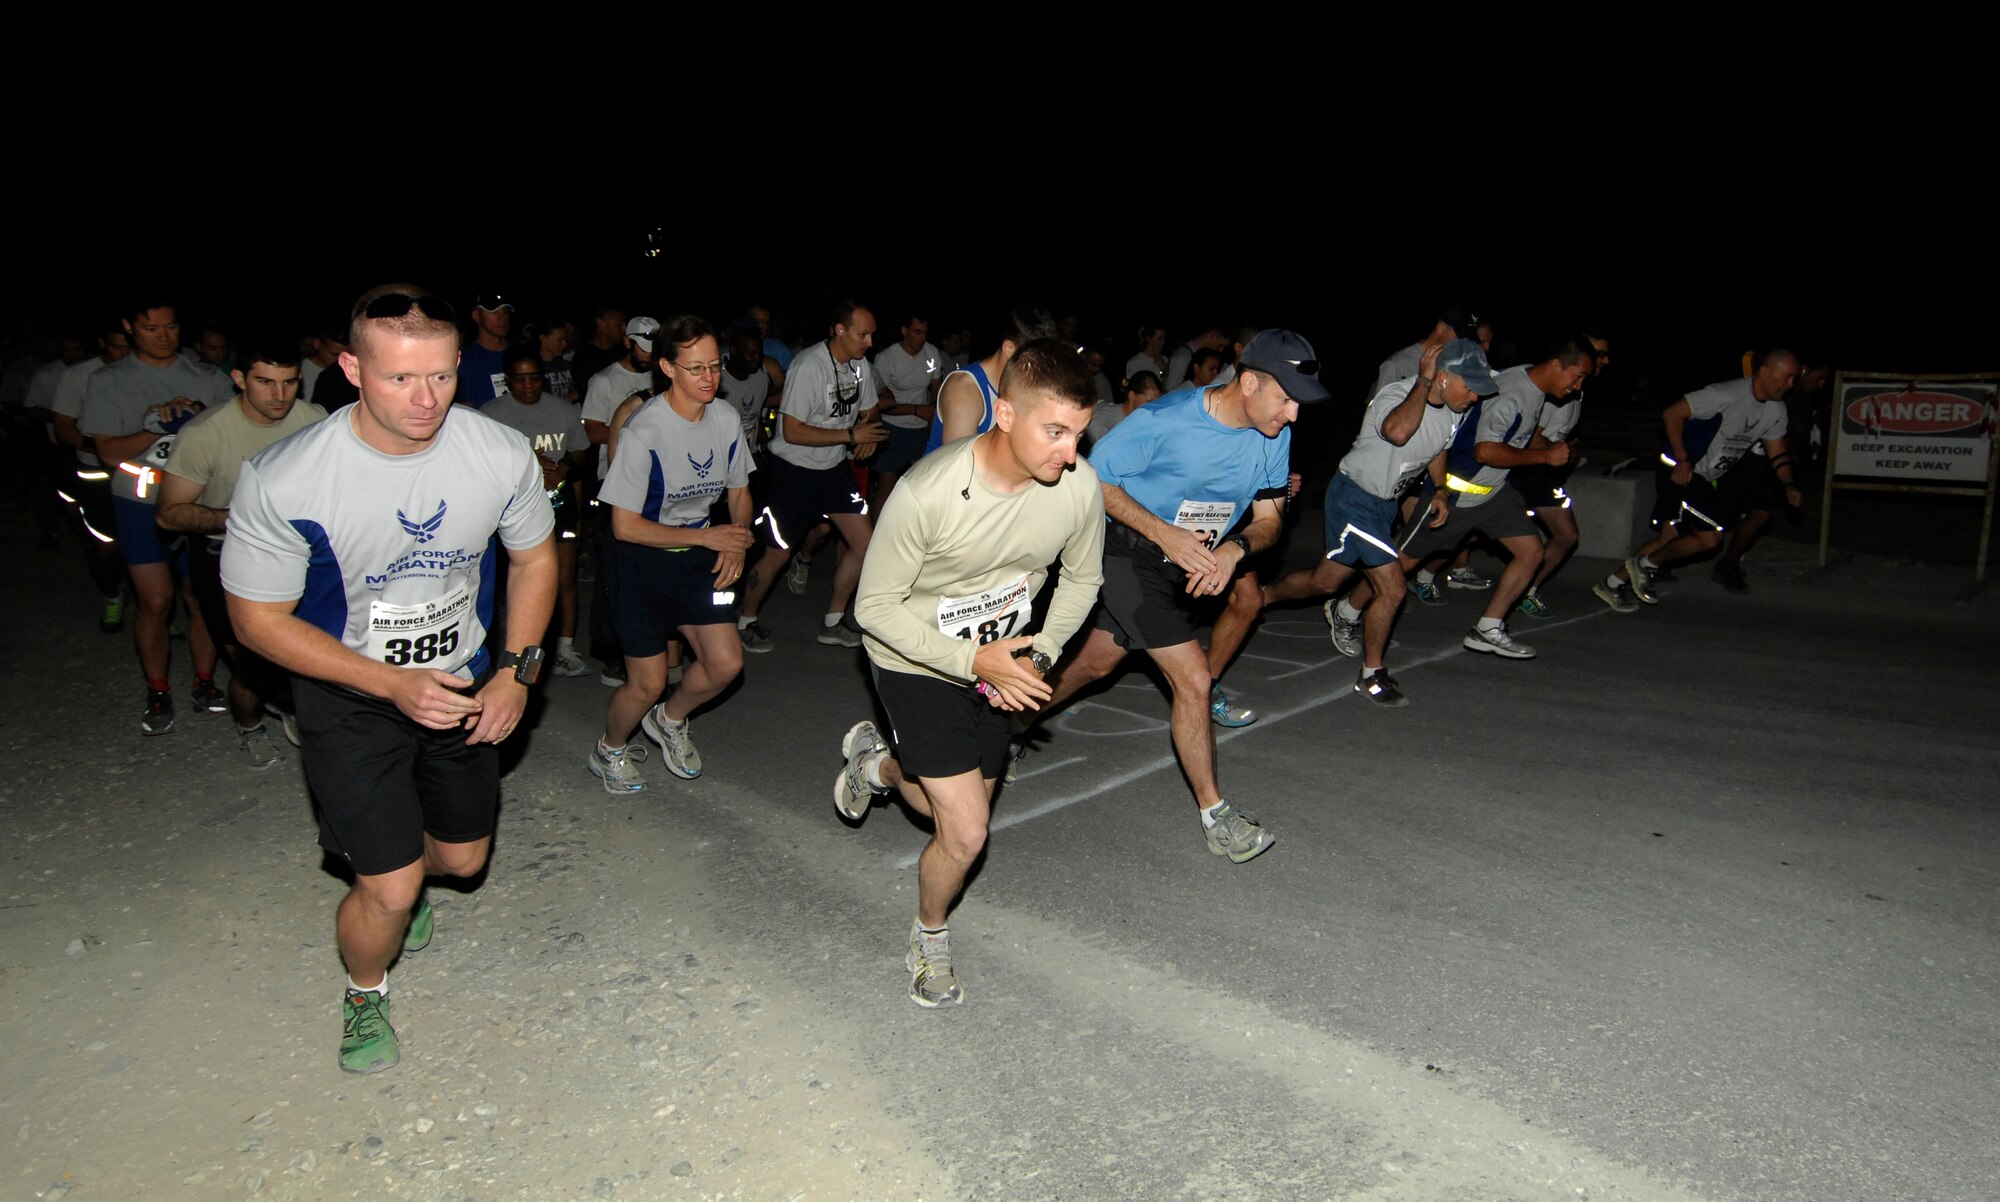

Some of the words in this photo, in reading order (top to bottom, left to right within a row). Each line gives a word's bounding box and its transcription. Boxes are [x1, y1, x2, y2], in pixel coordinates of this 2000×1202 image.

[1851, 443, 1885, 453] DEEP
[1888, 444, 1973, 456] EXCAVATION
[1875, 459, 1910, 469] KEEP
[1913, 460, 1952, 471] AWAY
[667, 486, 726, 499] MARATHO
[697, 480, 724, 489] FORCE
[365, 552, 480, 584] MARATHON
[386, 555, 409, 571] AIR
[412, 548, 465, 558] FORCE
[394, 617, 425, 625] FORCE
[428, 594, 470, 621] MARATHON
[940, 611, 955, 620] AIR
[957, 604, 982, 615] FORCE
[984, 586, 1027, 609] MARATHON
[956, 610, 1019, 646] 187
[384, 621, 460, 667] 385
